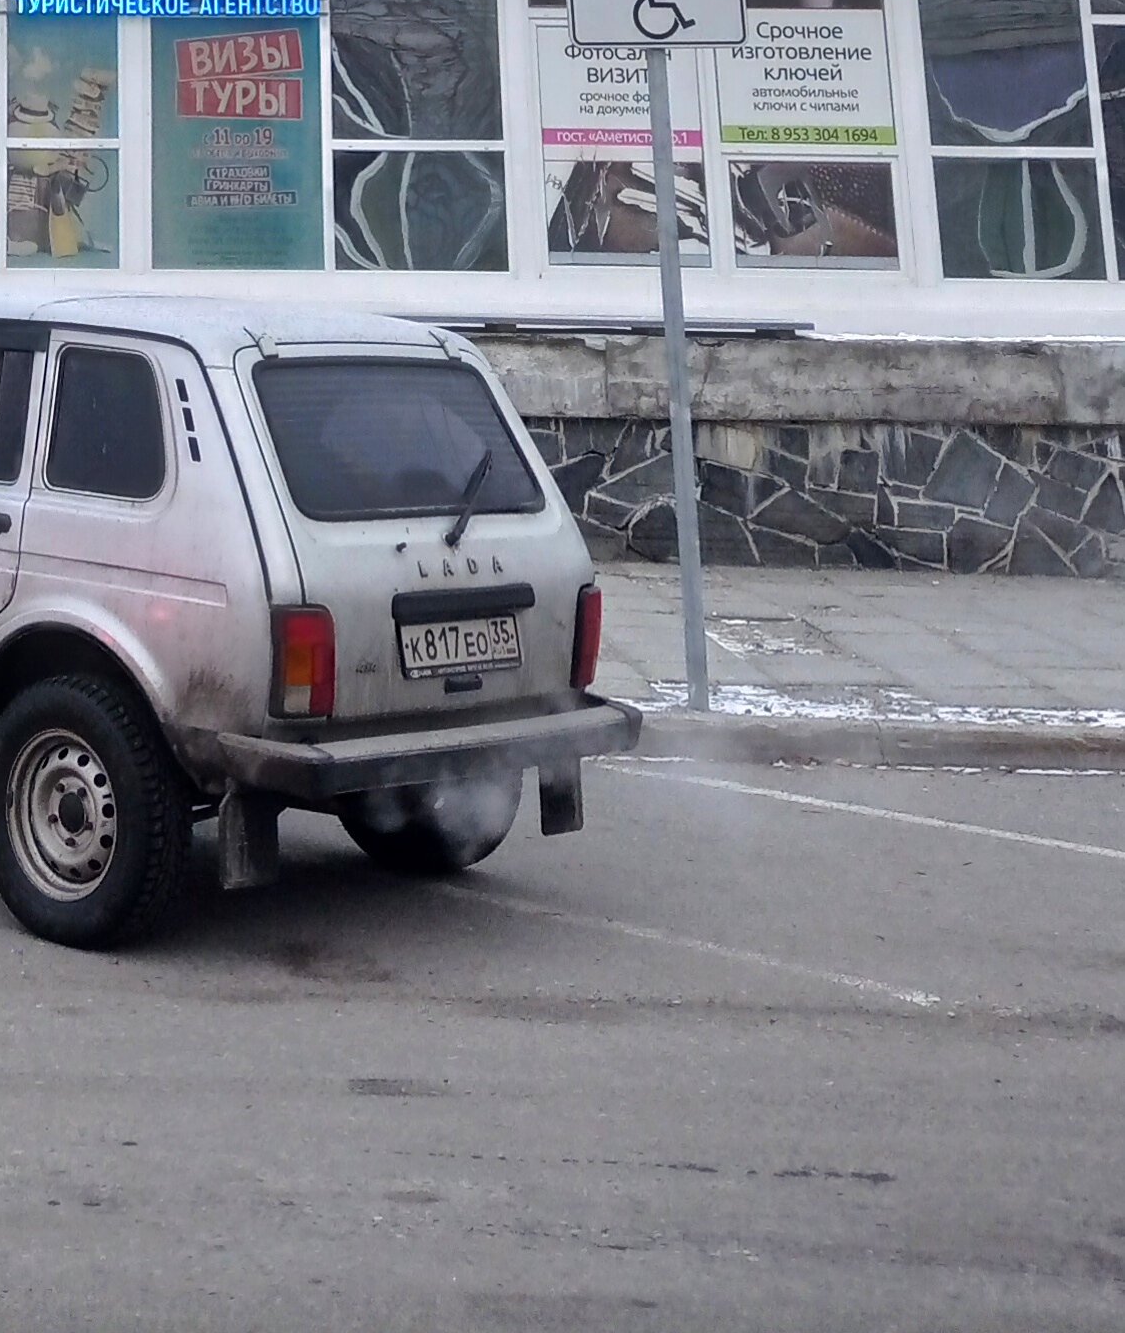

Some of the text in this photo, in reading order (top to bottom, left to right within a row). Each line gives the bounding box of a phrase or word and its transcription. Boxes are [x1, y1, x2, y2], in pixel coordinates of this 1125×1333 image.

[756, 21, 843, 42] Срочное
[190, 34, 290, 75] ВИЗЫ
[732, 46, 872, 61] изготовление
[764, 63, 843, 81] ключей
[192, 82, 287, 114] ТУРЫ
[579, 92, 629, 105] срочное
[752, 85, 859, 99] автомобильные
[579, 104, 594, 114] на
[753, 102, 860, 113] ключи с чипами
[214, 127, 231, 145] 11
[255, 127, 272, 145] 19
[739, 127, 879, 142] Тел: 8 953 304 1694
[209, 166, 268, 179] СТРАХОВКИ
[206, 179, 269, 191] ГРИНКАРТЫ
[191, 196, 217, 207] АВИА
[220, 196, 227, 206] И
[253, 193, 293, 205] БИЛЕТЫ
[418, 555, 504, 579] LADA
[491, 619, 509, 645] 35
